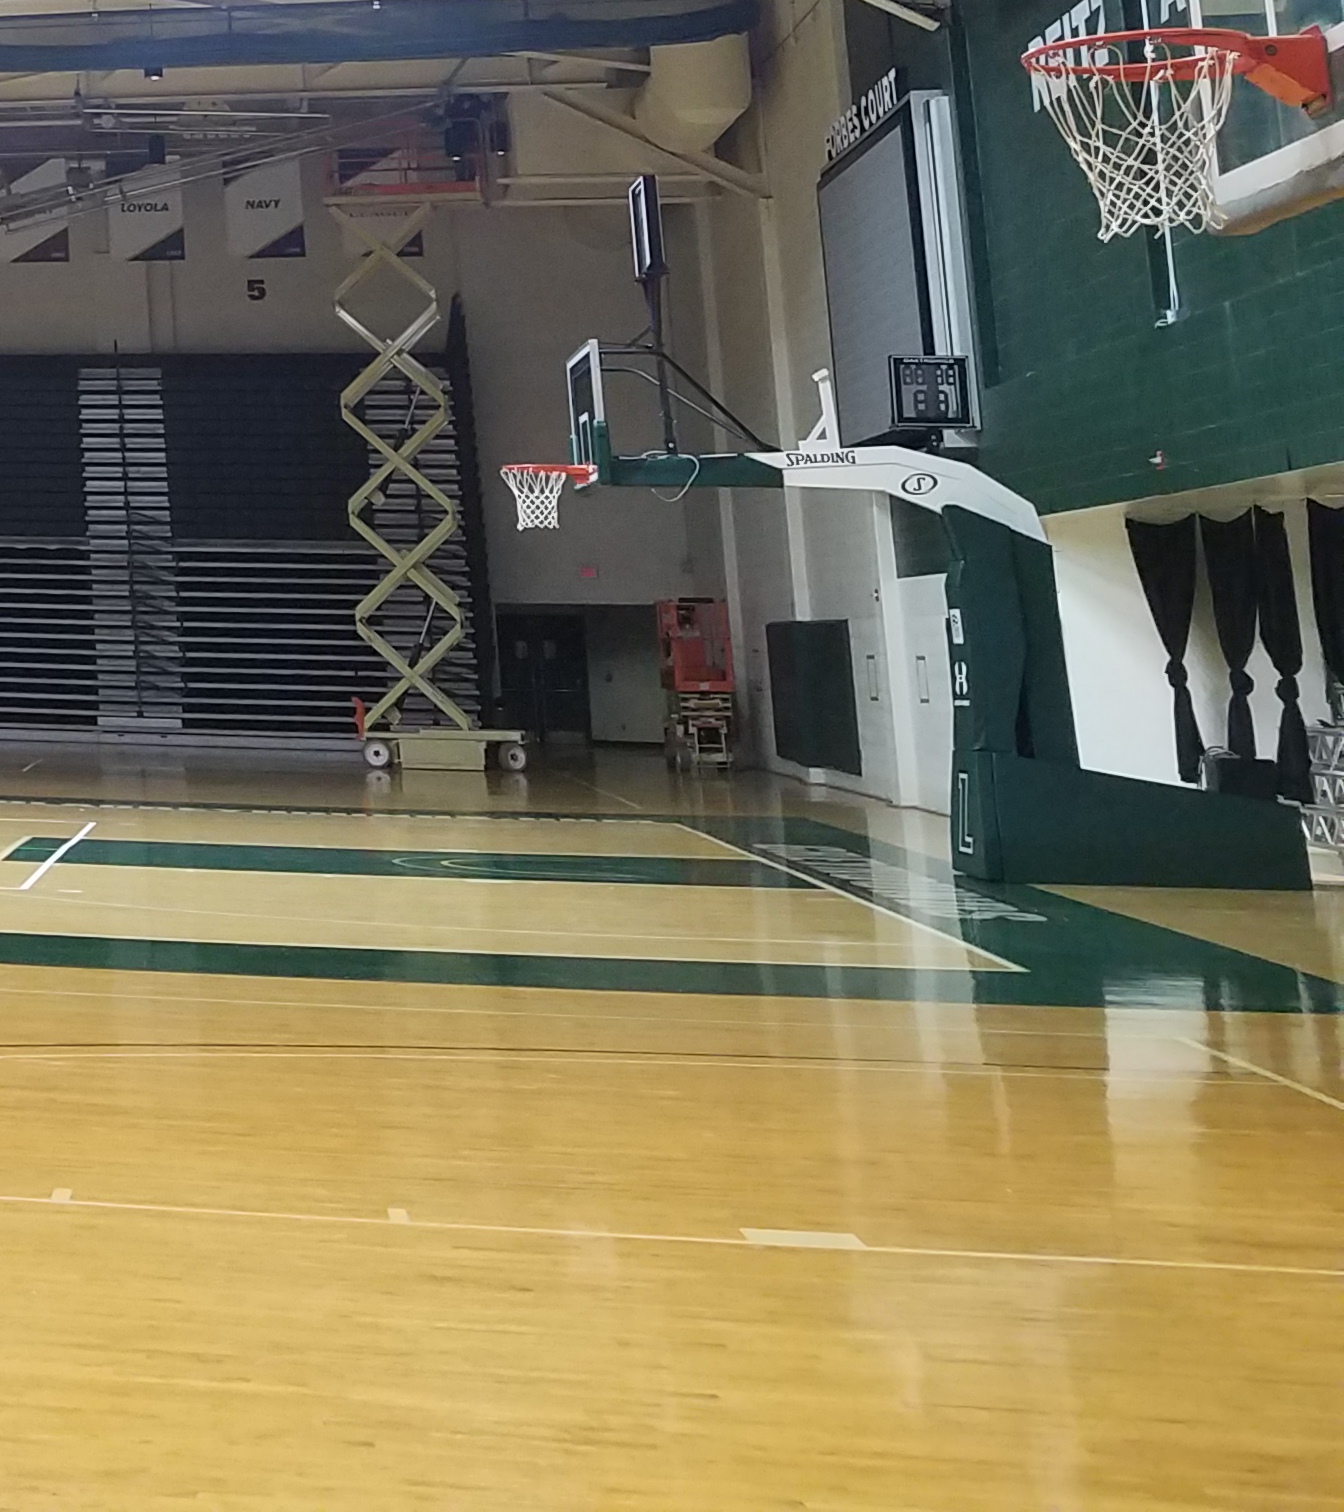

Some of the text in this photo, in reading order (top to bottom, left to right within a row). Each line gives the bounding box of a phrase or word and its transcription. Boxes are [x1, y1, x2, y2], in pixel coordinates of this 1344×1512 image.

[860, 67, 897, 130] COURT
[121, 202, 170, 213] LOYOLA
[245, 199, 281, 210] NAVY
[246, 279, 267, 301] 5
[785, 450, 856, 467] SPALDING
